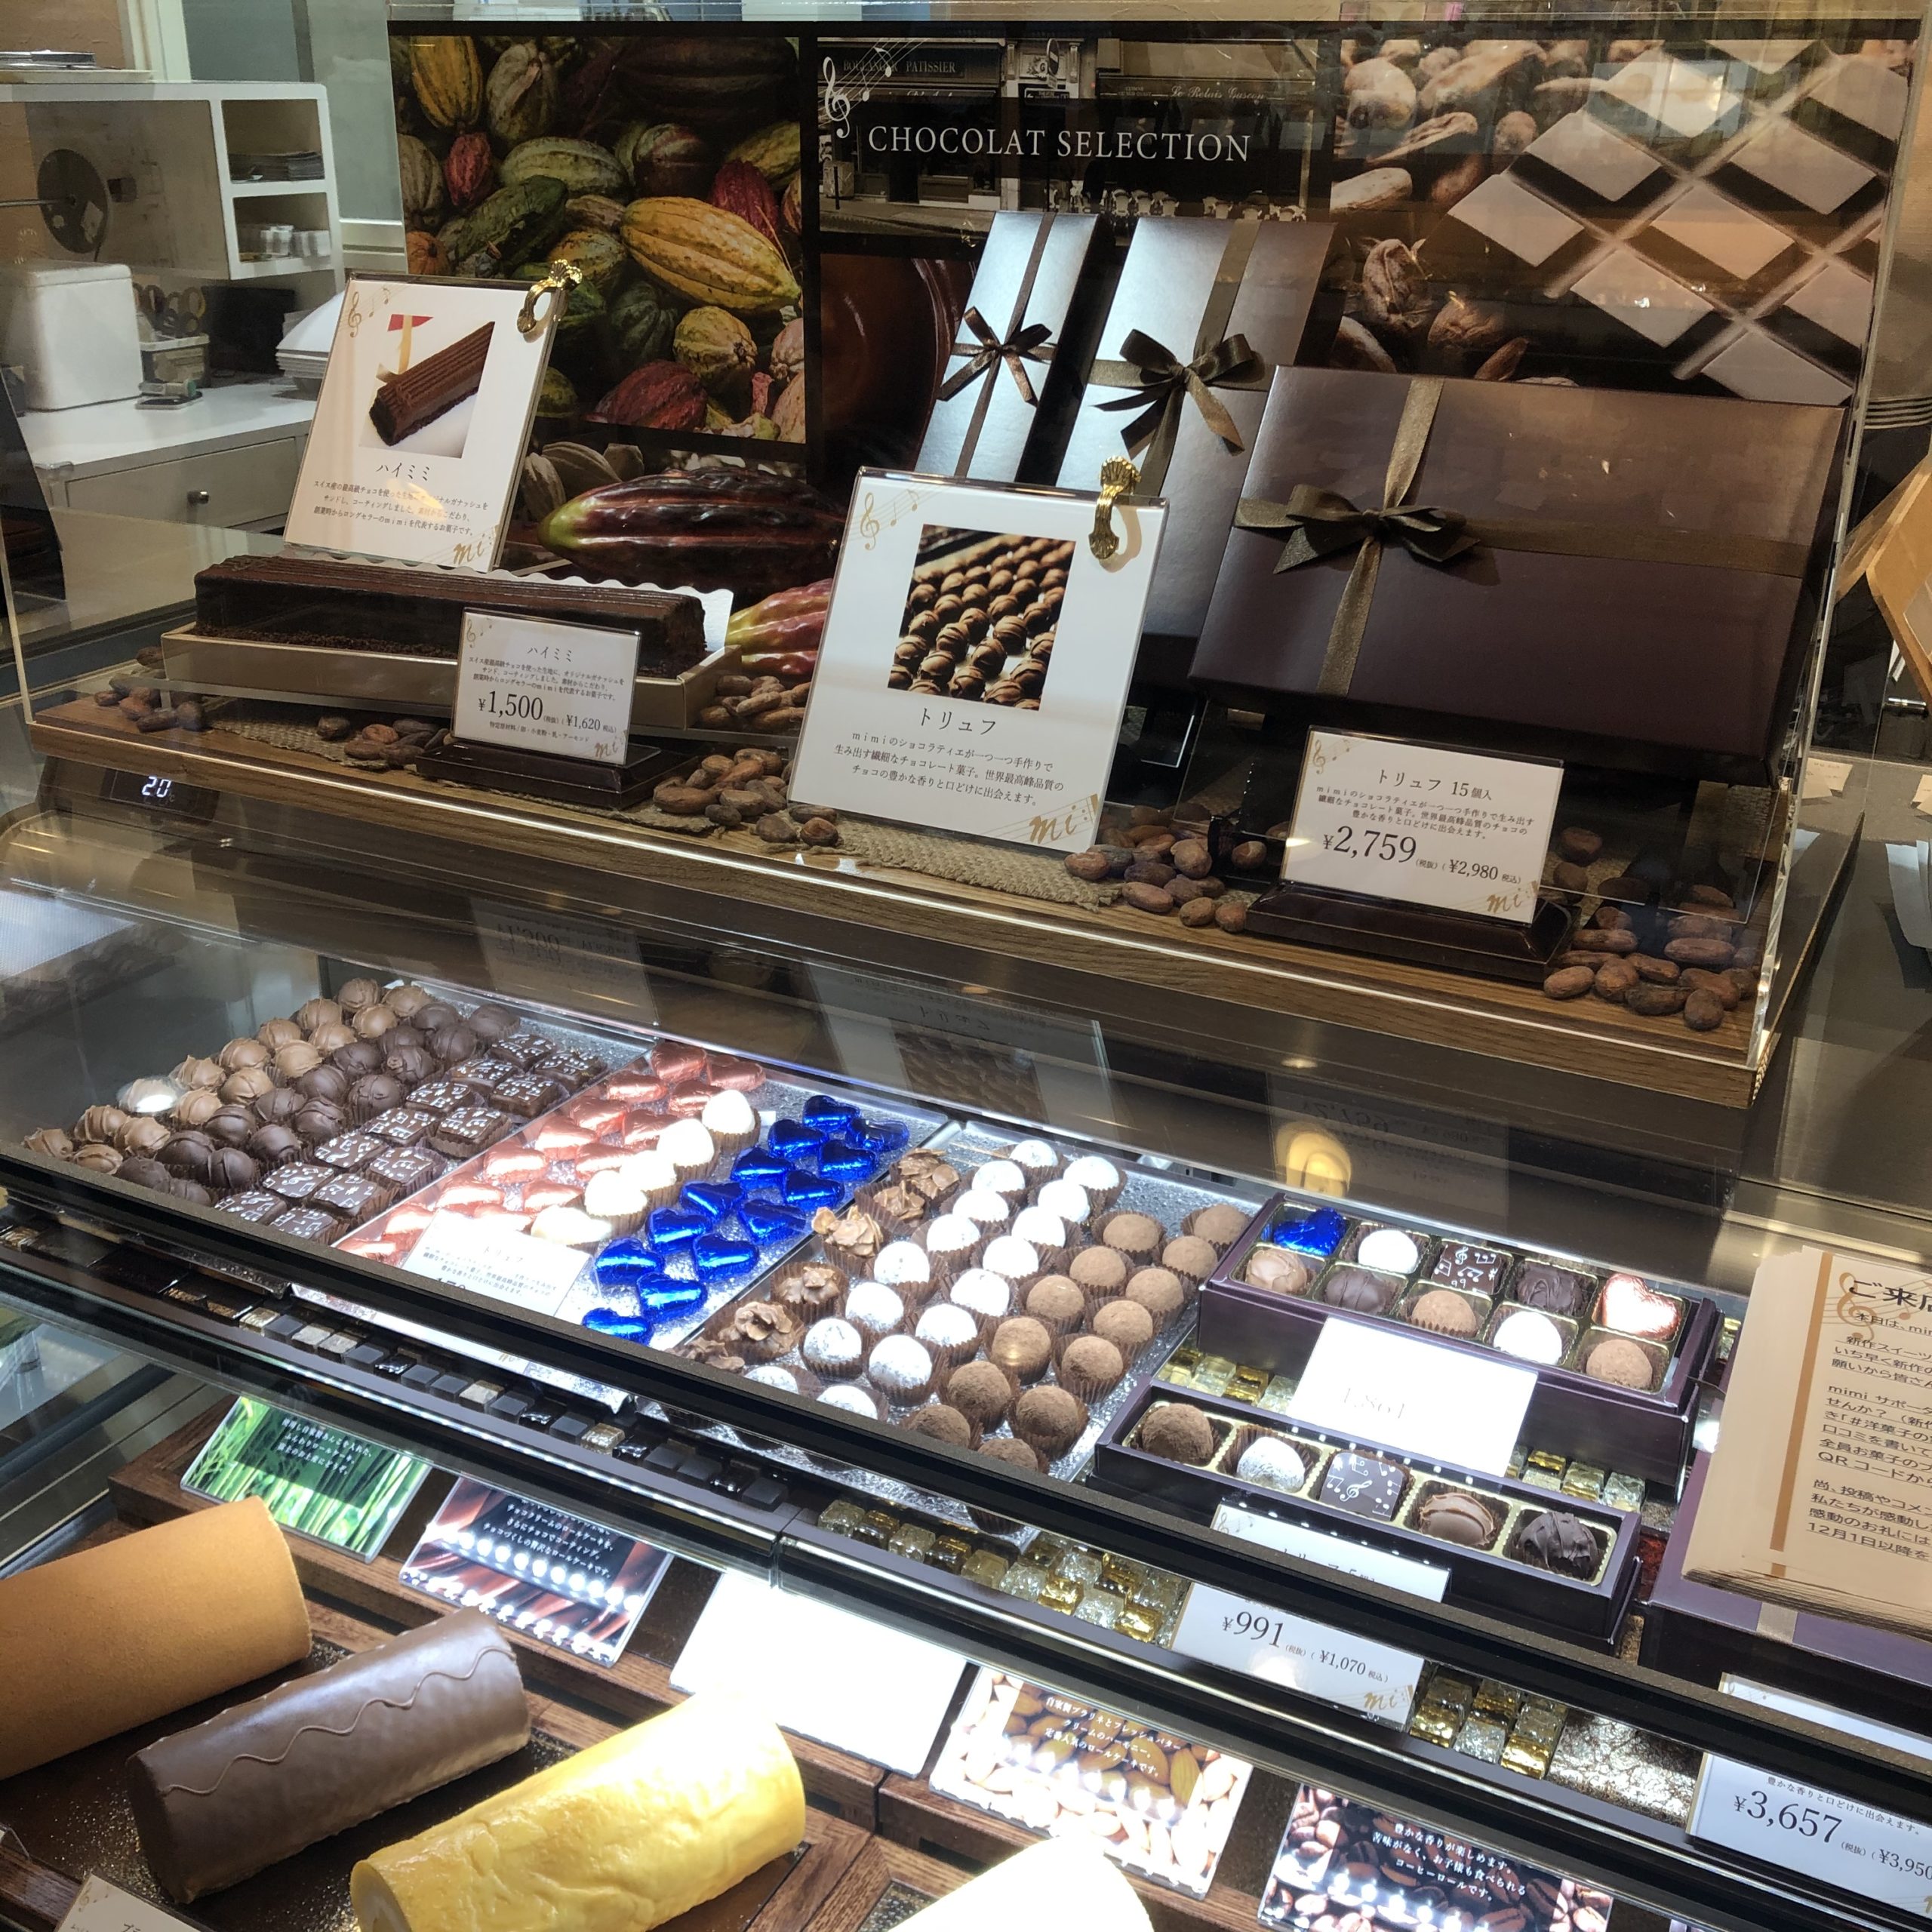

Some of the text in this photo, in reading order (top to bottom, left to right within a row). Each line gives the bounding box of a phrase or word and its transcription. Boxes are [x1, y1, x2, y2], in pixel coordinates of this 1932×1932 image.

[906, 61, 955, 72] PATISSIER
[869, 125, 1250, 162] CHOCOLAT SELECTION
[377, 462, 430, 481] ハイミミ
[528, 646, 572, 663] ハイミミ
[478, 691, 543, 720] ¥1,500
[920, 707, 996, 736] トリュフ
[141, 776, 172, 798] 20
[852, 764, 1038, 807] チョコの豊かな香りと口どけに出会えます。
[1380, 769, 1493, 801] トリュフ 15個入
[1322, 826, 1417, 863] ¥2,759
[1857, 1312, 1932, 1335] 本日は、mi
[1829, 1386, 1868, 1399] mimi
[1825, 1411, 1932, 1443] き「#洋菓子の
[1818, 1452, 1847, 1466] QR
[1811, 1493, 1932, 1531] 私たちが感動し
[1222, 1611, 1284, 1648] ¥991
[1734, 1791, 1842, 1843] ¥3,657
[1767, 1776, 1920, 1835] 豊かな香りと口どけに出会えます。
